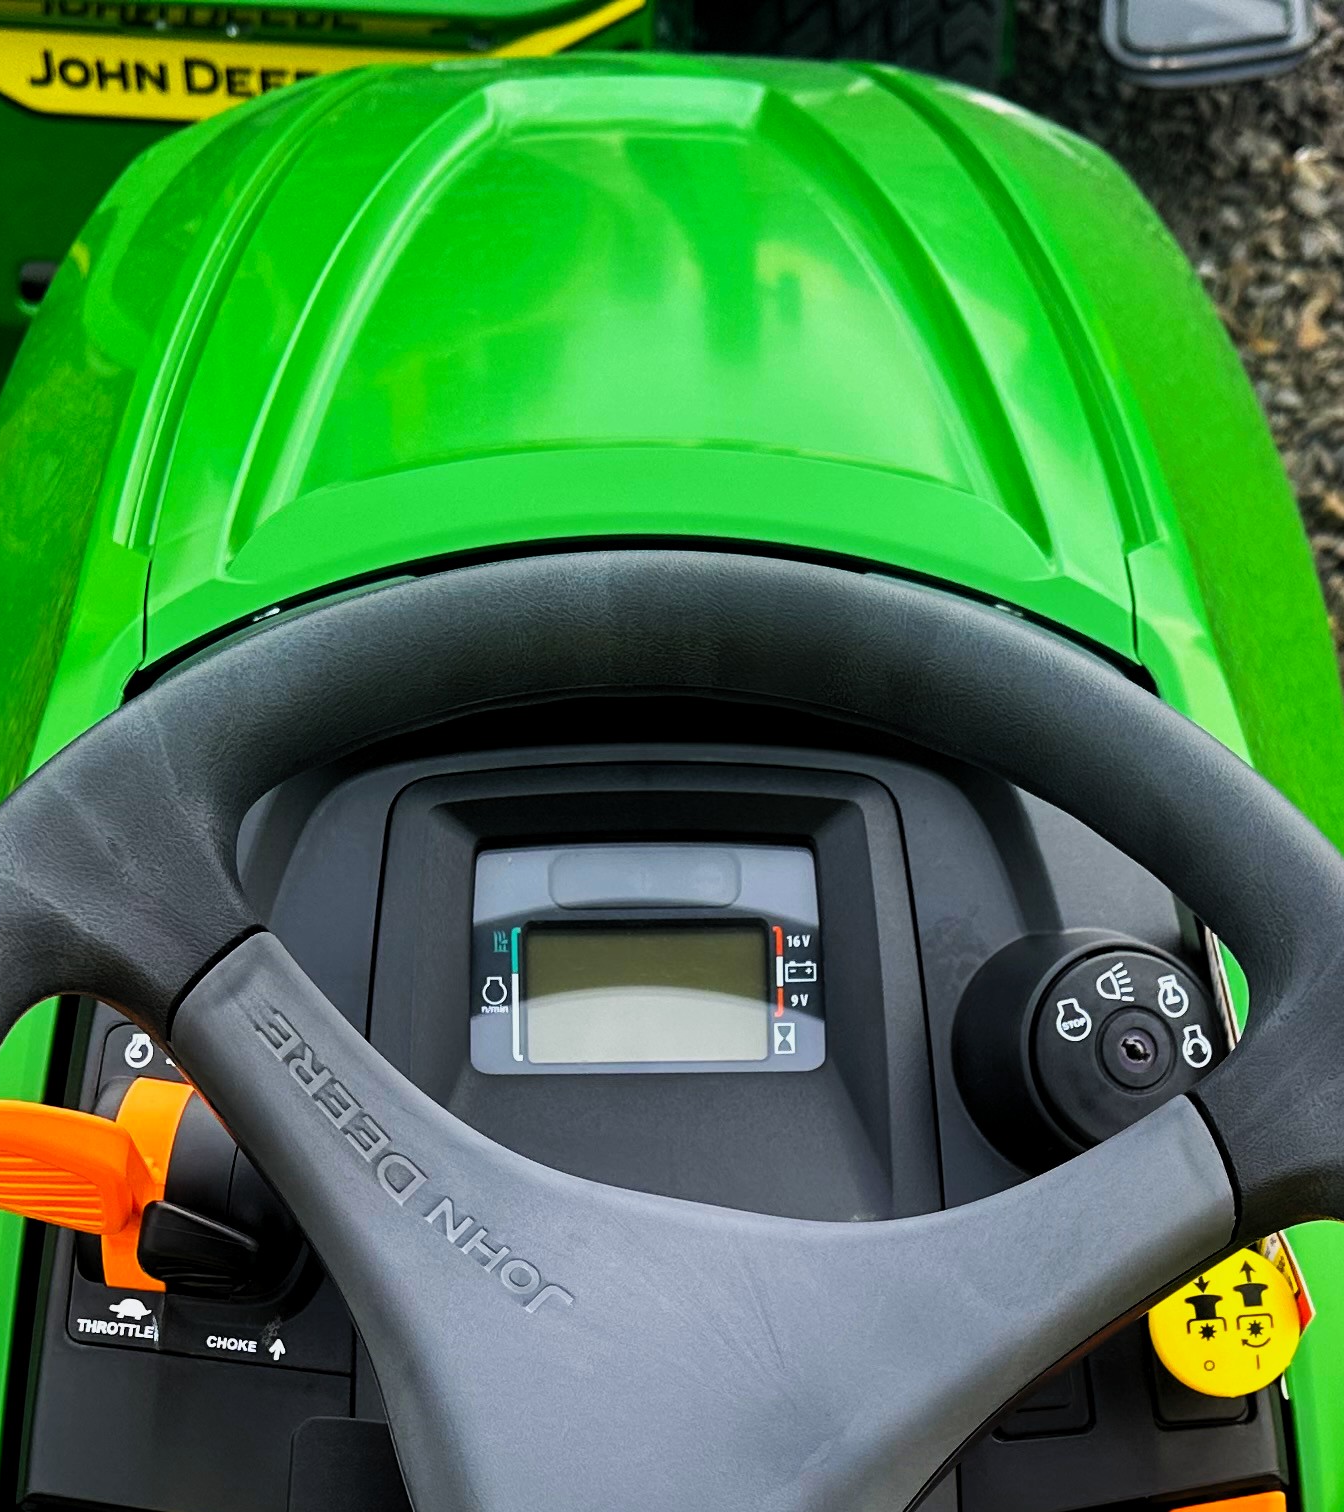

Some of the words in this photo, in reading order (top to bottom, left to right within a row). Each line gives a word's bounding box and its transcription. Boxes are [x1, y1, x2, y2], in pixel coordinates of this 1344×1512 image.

[29, 48, 170, 94] JOHN
[1061, 1016, 1087, 1031] STOP
[255, 1008, 429, 1207] DEERE
[424, 1196, 575, 1314] JOHN
[77, 1318, 155, 1340] THROTTLE
[206, 1335, 257, 1353] CHOKE
